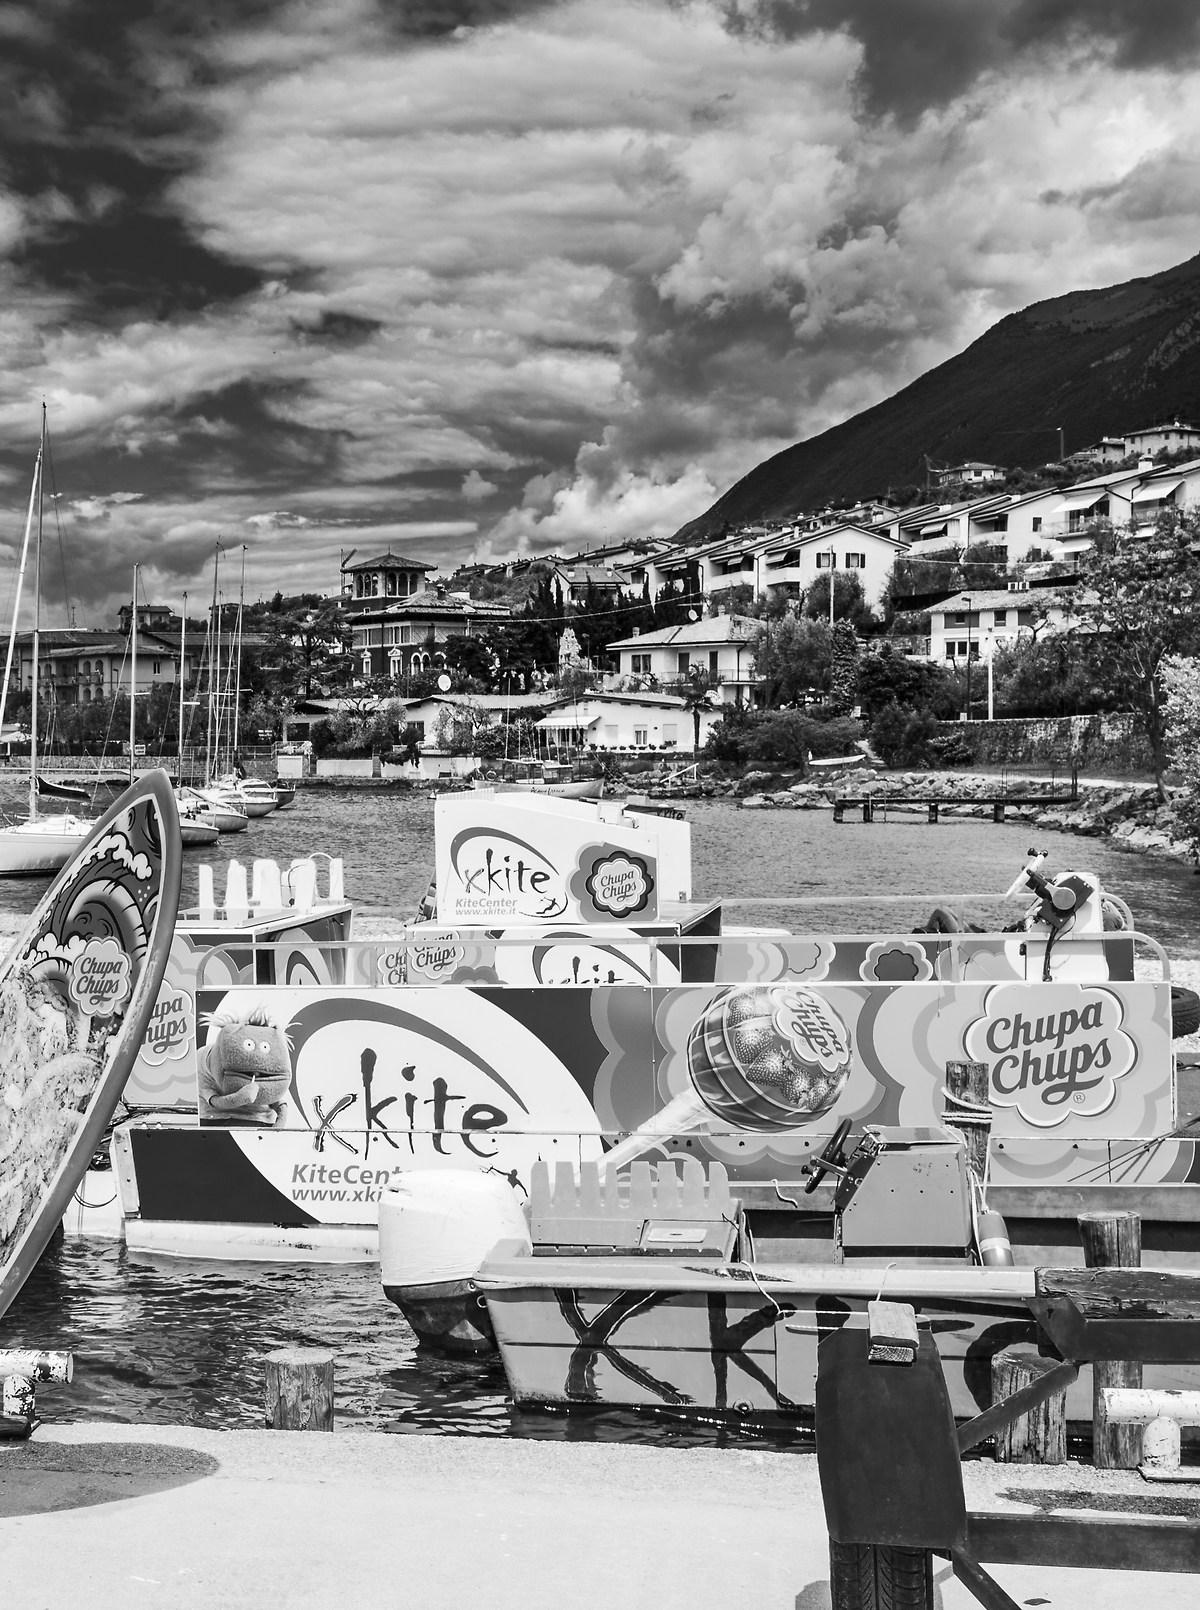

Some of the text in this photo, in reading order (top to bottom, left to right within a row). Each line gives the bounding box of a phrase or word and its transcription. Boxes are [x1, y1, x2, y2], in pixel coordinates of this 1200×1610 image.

[464, 848, 551, 896] xkite
[600, 869, 634, 887] Chupa
[455, 898, 518, 908] KiteCenter
[602, 882, 637, 902] Chups
[455, 907, 516, 916] www.xkite.it
[80, 957, 123, 979] Chupa
[416, 947, 456, 972] Chups
[76, 975, 119, 1006] Chups
[150, 997, 183, 1023] upa
[796, 991, 844, 1053] Chupa
[782, 996, 834, 1058] Chups
[986, 1001, 1103, 1053] Chupa
[992, 1038, 1112, 1105] Chups
[311, 1047, 508, 1160] xkite
[291, 1164, 402, 1185] KiteCen
[291, 1186, 384, 1202] www.xki
